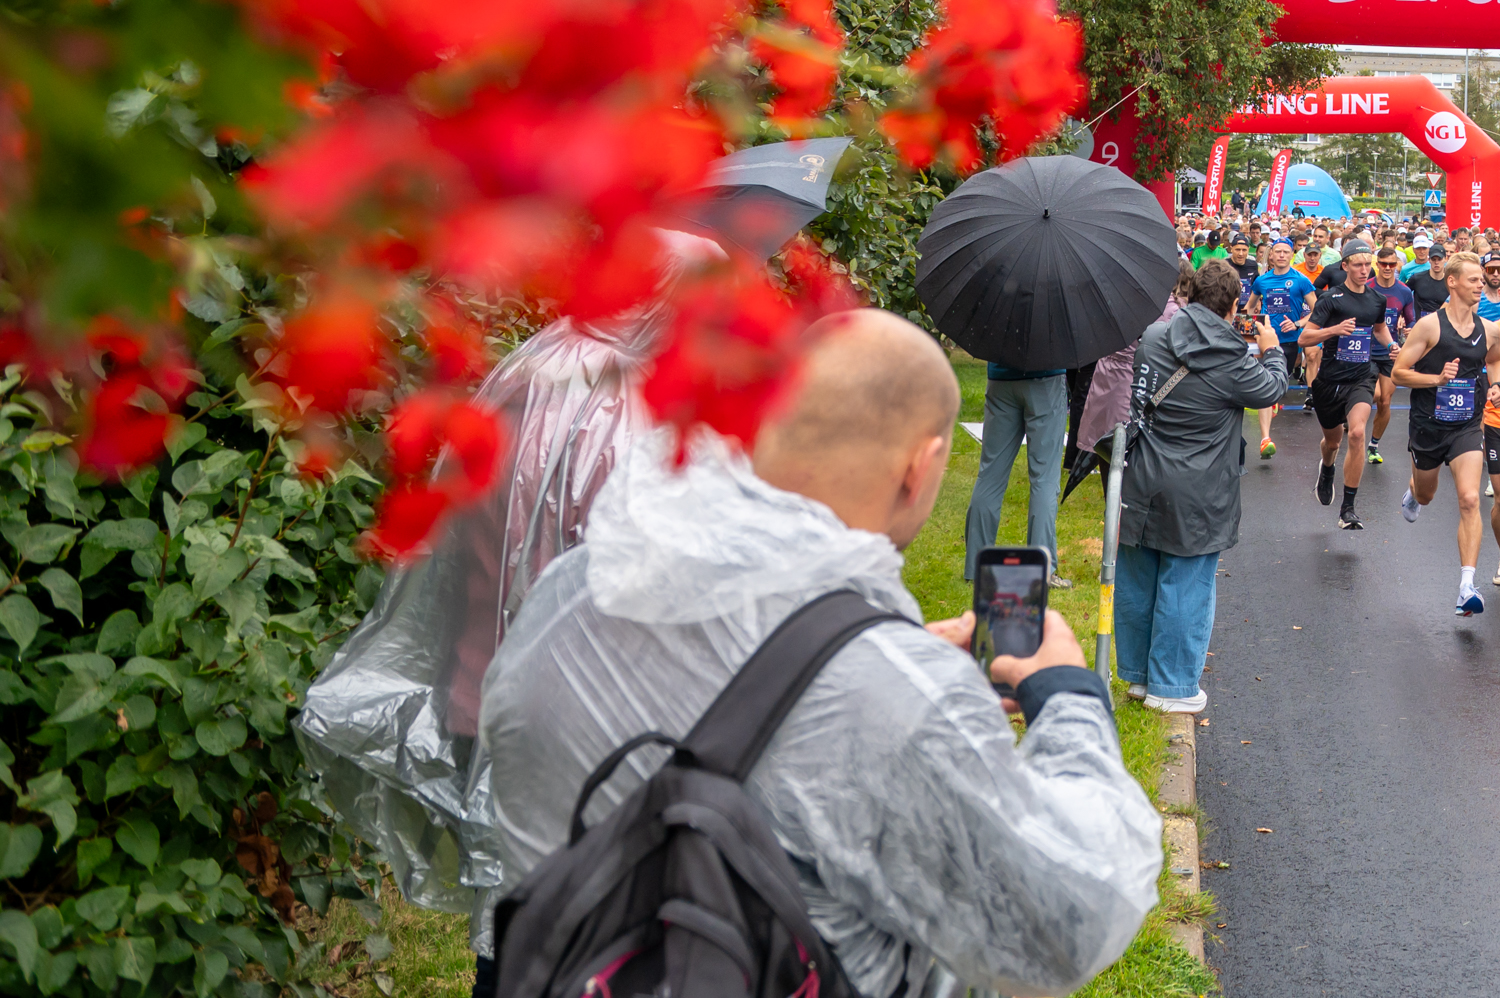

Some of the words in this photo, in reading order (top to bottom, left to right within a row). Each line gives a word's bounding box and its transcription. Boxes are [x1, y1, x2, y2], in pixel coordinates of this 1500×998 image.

[1325, 93, 1390, 115] LINE
[1209, 144, 1223, 200] SPORTLAND
[1271, 155, 1287, 206] SPORTLAND
[1471, 181, 1482, 210] LINE
[1273, 297, 1283, 305] 22
[1347, 340, 1361, 350] 28
[1448, 394, 1464, 407] 38
